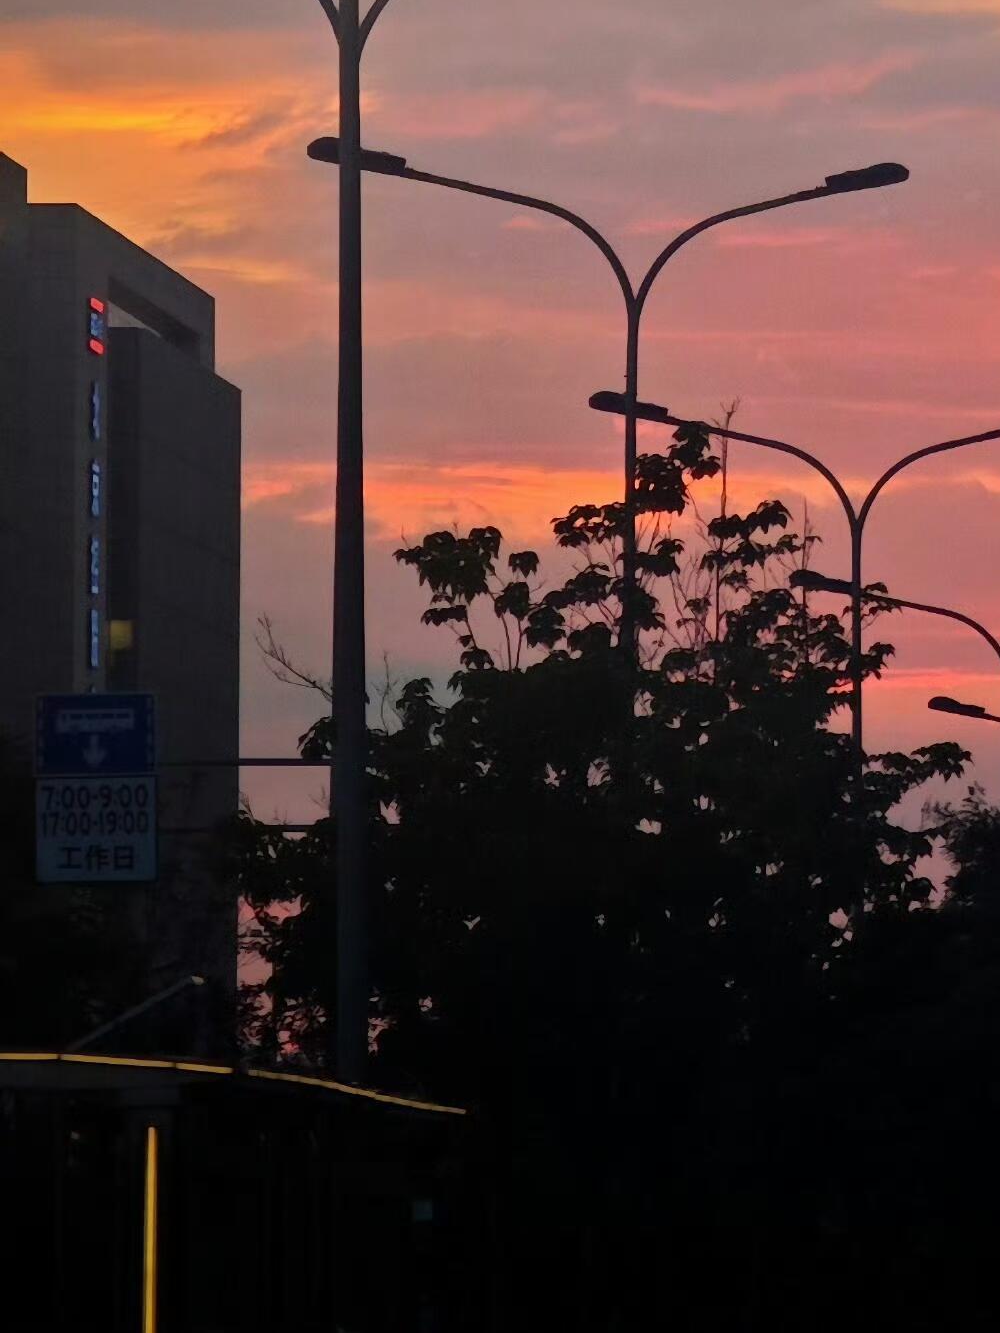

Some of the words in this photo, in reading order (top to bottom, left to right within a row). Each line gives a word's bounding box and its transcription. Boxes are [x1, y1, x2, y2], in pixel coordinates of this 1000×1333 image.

[41, 784, 148, 810] 7:00-9:00
[42, 810, 148, 837] 17:00-19:00
[56, 845, 134, 871] 工作日
